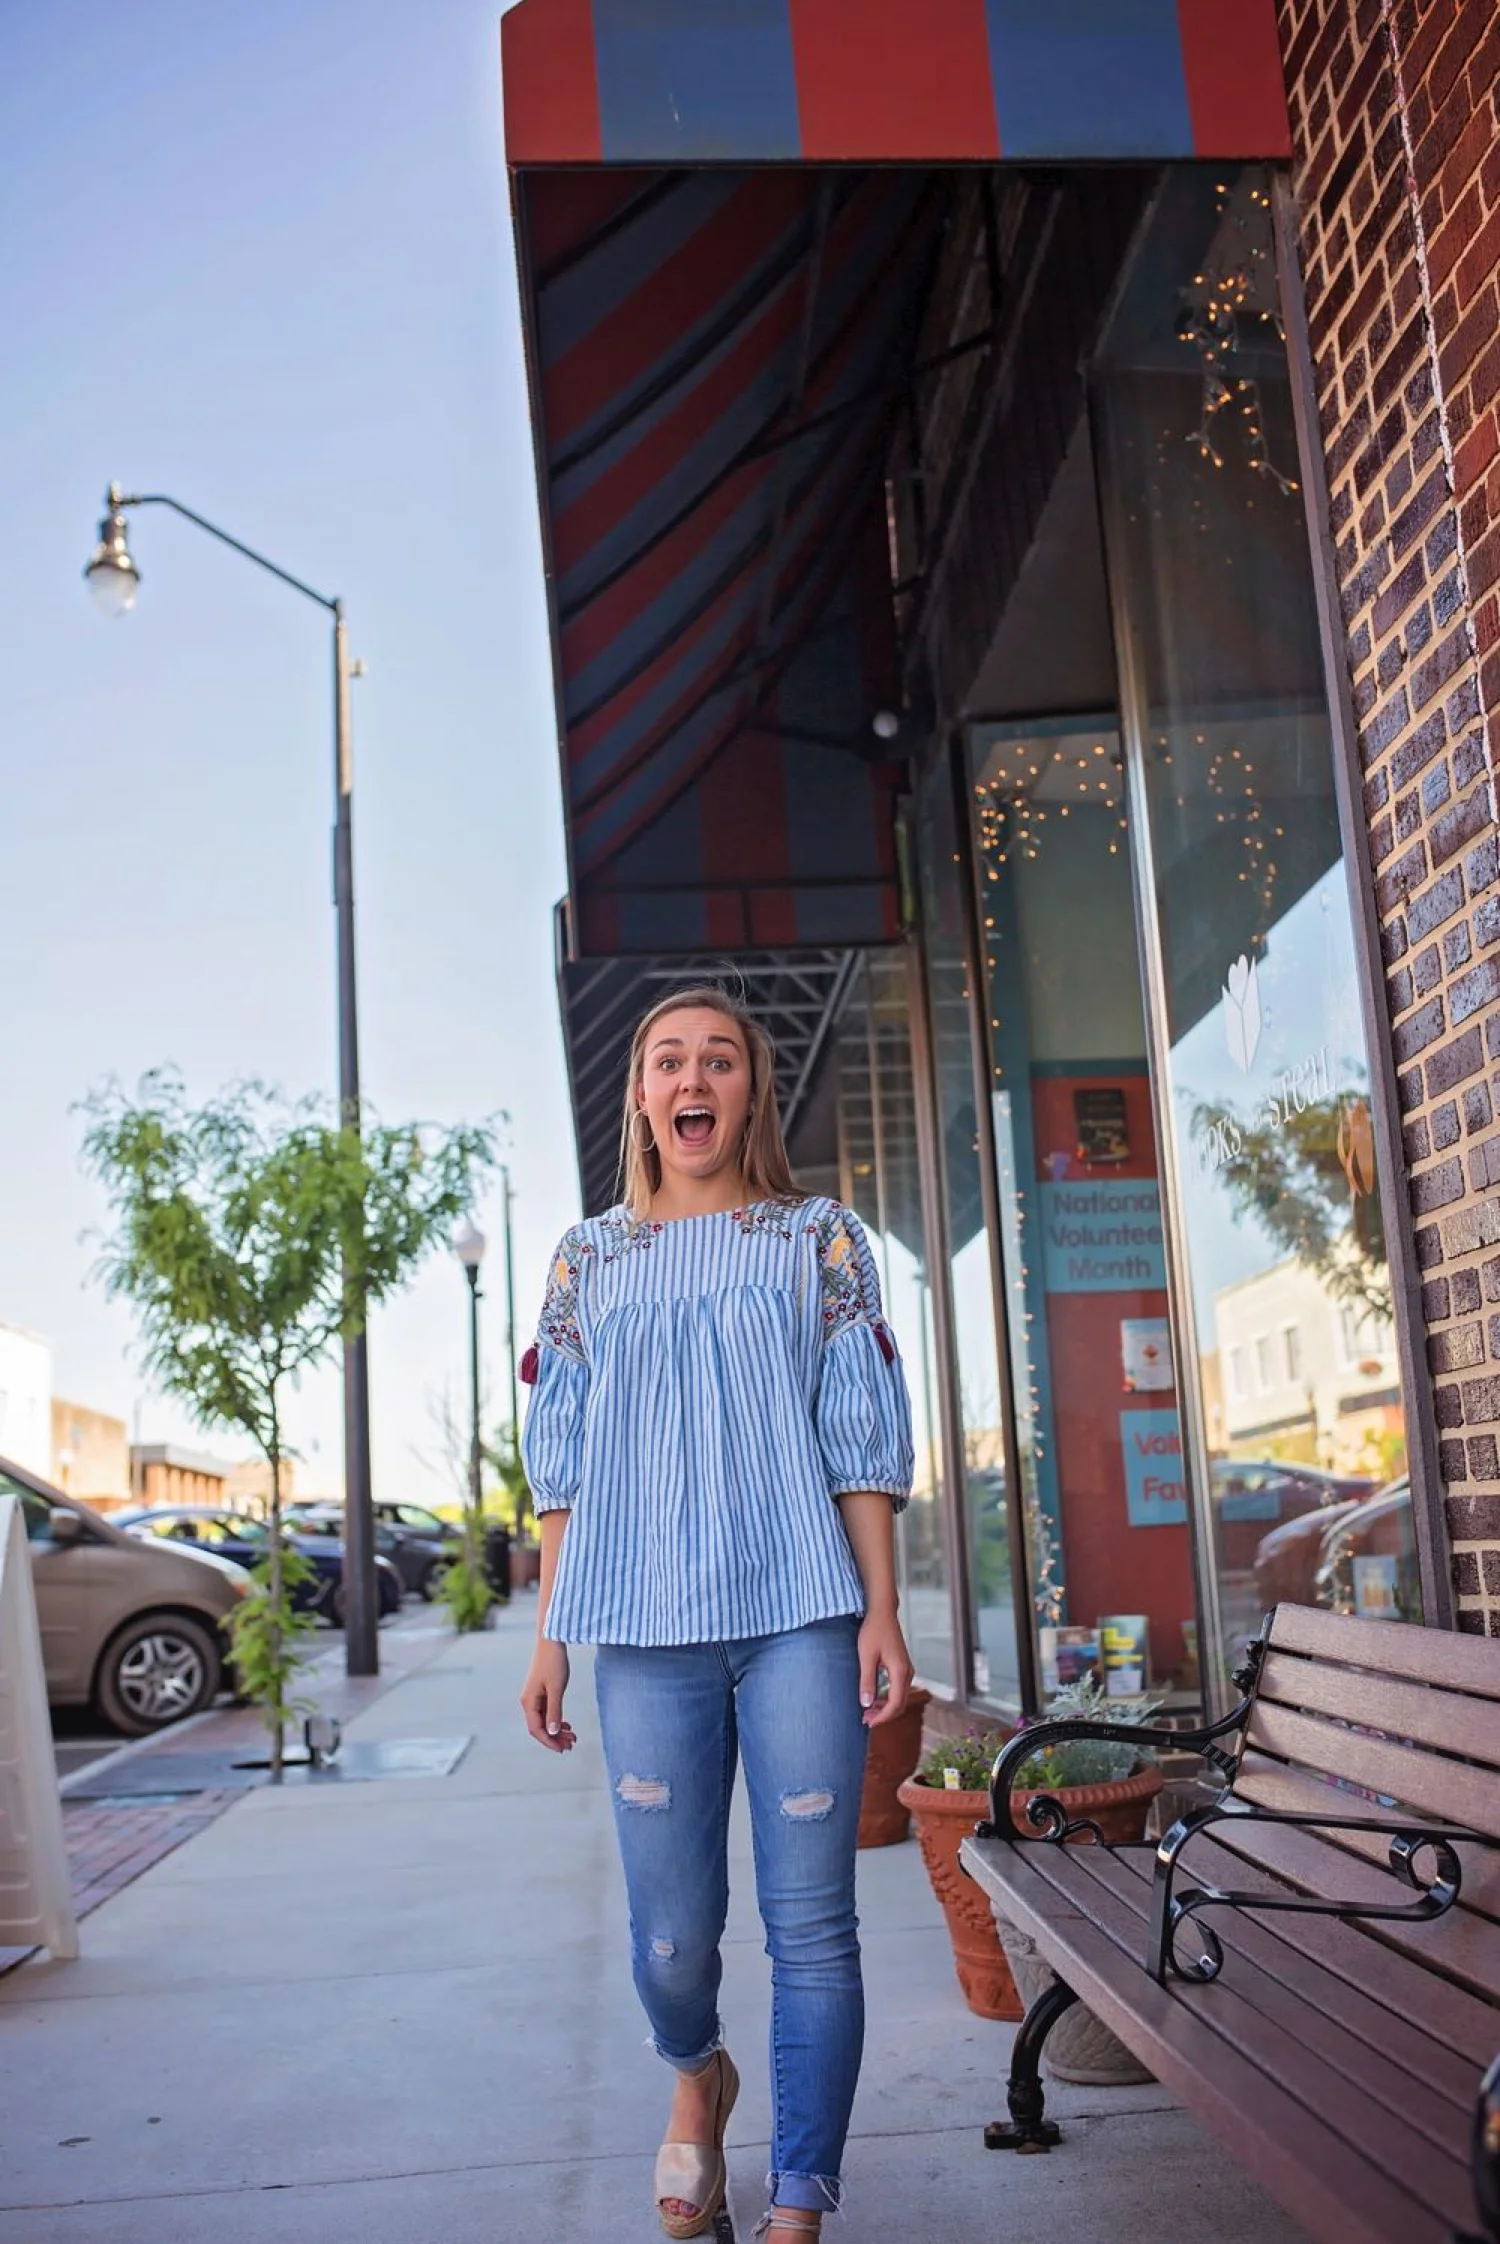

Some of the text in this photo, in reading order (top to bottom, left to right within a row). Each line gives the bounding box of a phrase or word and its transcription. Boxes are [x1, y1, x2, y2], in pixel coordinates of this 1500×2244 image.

[1054, 1190, 1161, 1213] National
[1049, 1224, 1164, 1248] Voluntee
[1067, 1256, 1151, 1280] Month
